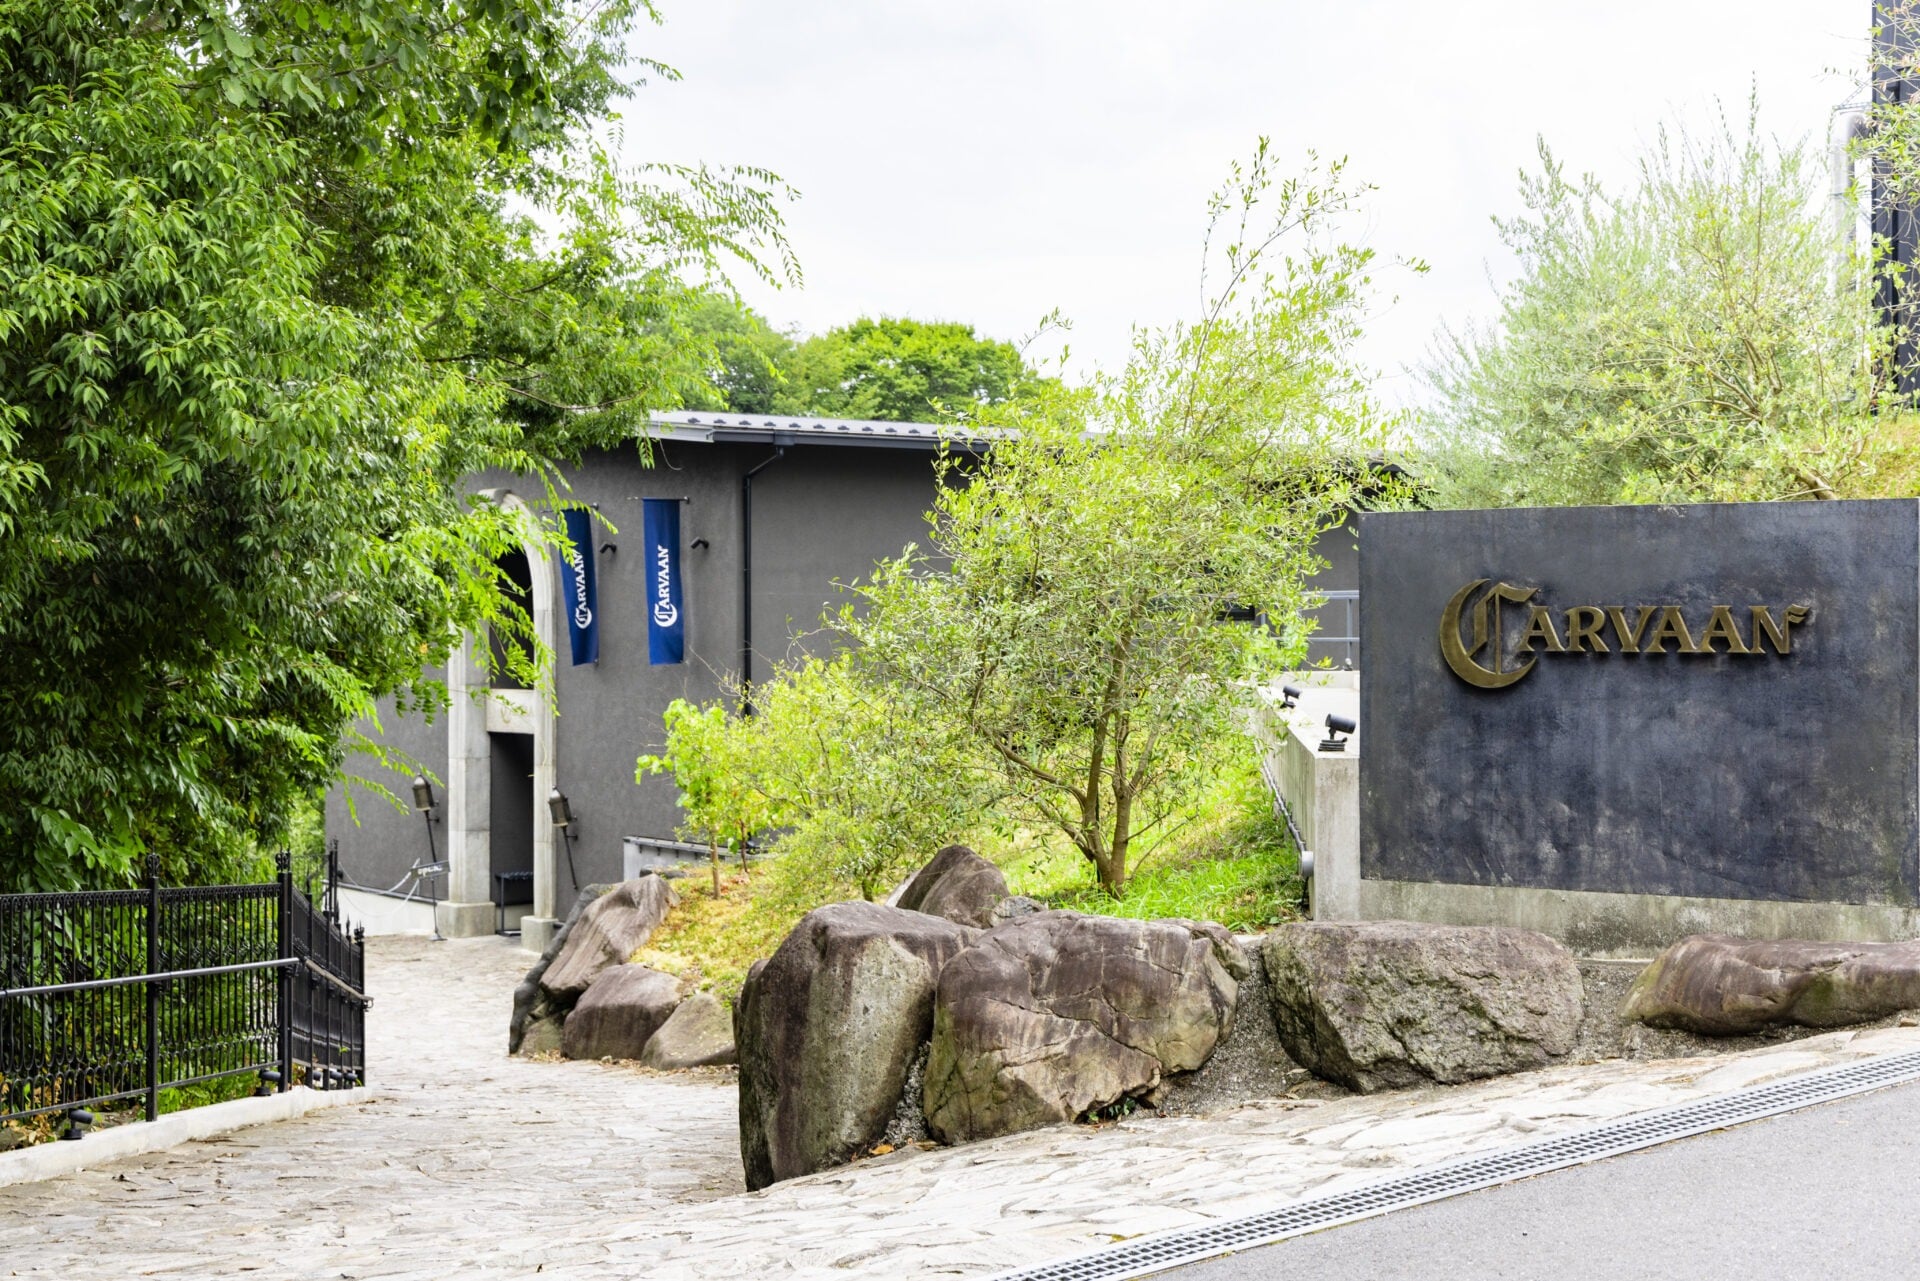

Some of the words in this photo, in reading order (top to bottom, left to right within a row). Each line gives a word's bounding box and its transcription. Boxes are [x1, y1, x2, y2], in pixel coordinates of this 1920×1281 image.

[574, 549, 592, 629] CARVAAN
[653, 544, 678, 627] CARVAAN
[1439, 578, 1811, 689] CARVAAN
